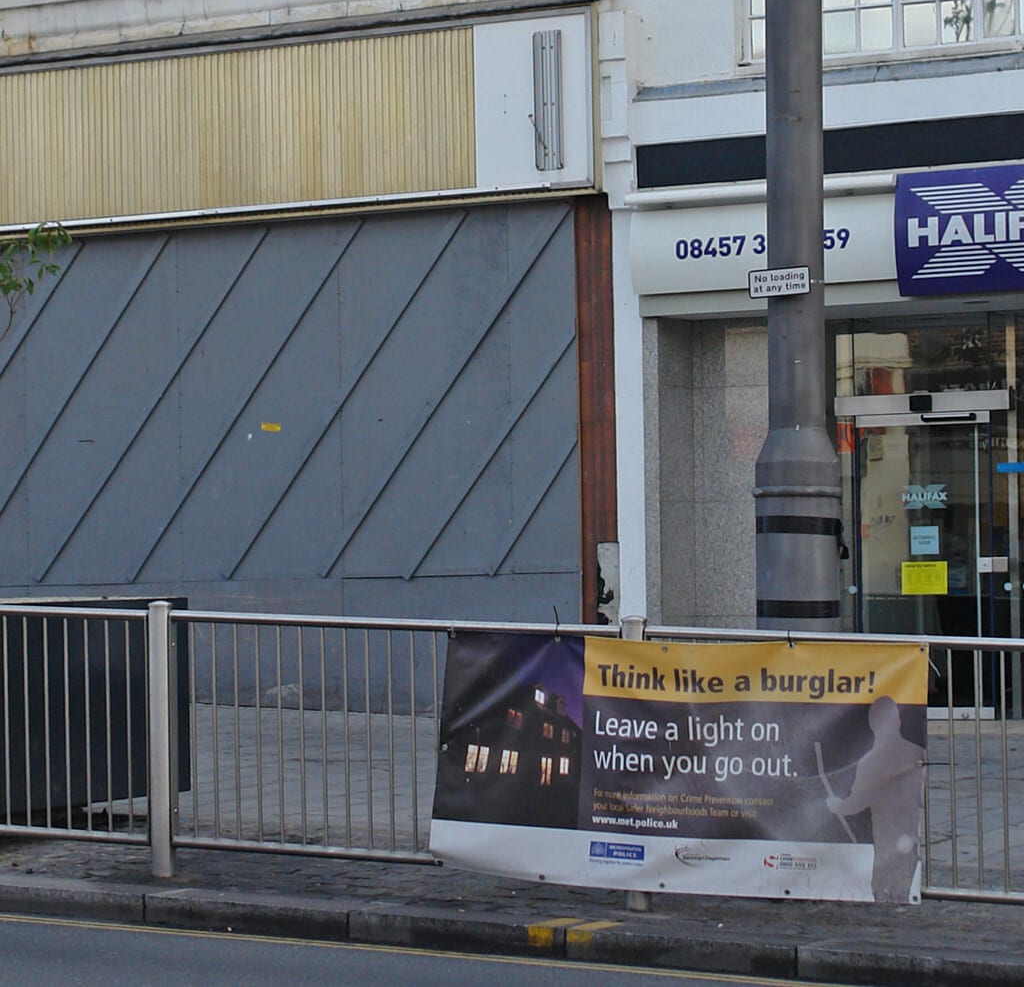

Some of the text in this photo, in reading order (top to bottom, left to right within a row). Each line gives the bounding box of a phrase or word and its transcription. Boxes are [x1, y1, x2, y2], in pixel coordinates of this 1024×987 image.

[675, 235, 746, 260] 08457
[754, 272, 805, 283] No loading
[753, 282, 806, 293] at any time
[902, 492, 947, 502] HALIFAX
[598, 664, 875, 699] Think like a burglar!
[594, 710, 780, 747] Leave a light on
[593, 744, 798, 781] when you go out.
[622, 790, 666, 802] information
[668, 794, 678, 802] on
[680, 793, 703, 804] Crime
[704, 794, 743, 805] Prevention
[744, 797, 773, 806] contact
[646, 804, 707, 817] Neighbourhoods
[709, 807, 728, 817] Team
[592, 815, 679, 829] www.met.police.uk
